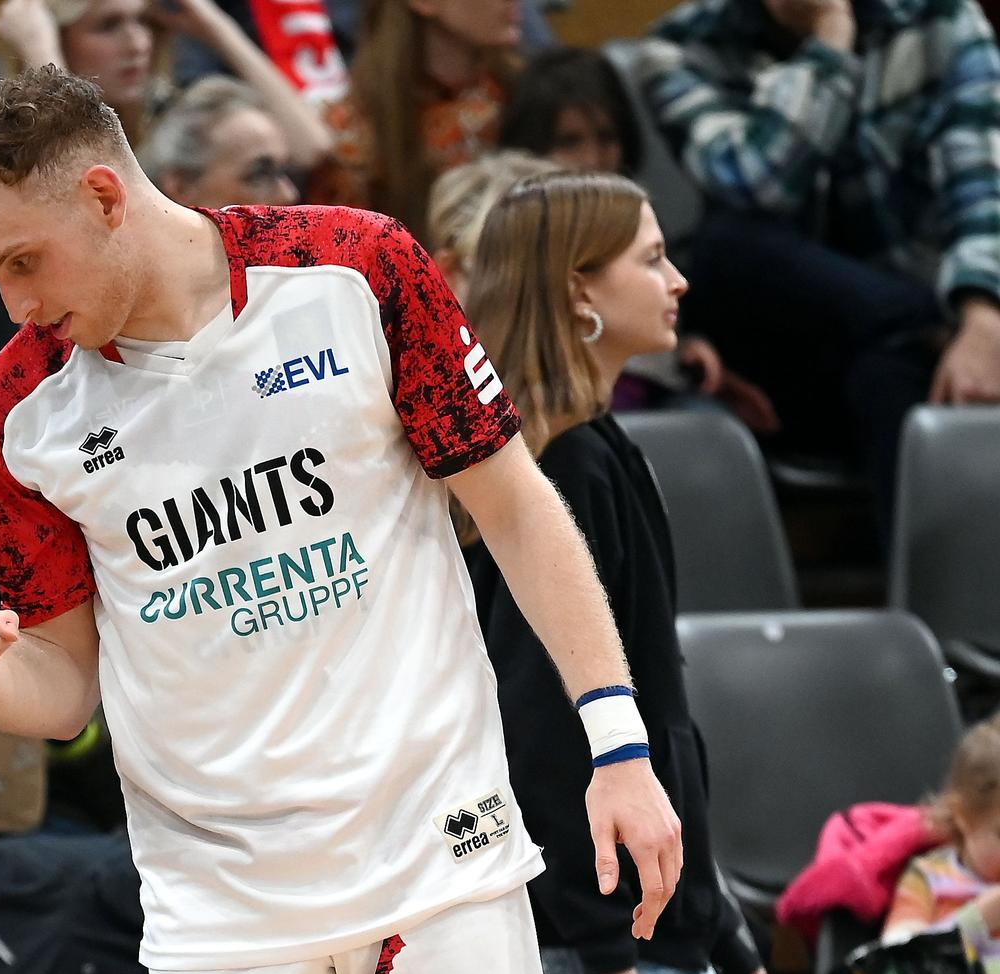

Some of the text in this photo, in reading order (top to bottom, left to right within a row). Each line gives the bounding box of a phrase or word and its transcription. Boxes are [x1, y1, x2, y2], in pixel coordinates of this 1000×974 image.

[283, 348, 349, 389] EVL
[126, 447, 335, 571] GIANTS
[139, 532, 365, 623] CURRENTA
[477, 794, 503, 813] SIZE
